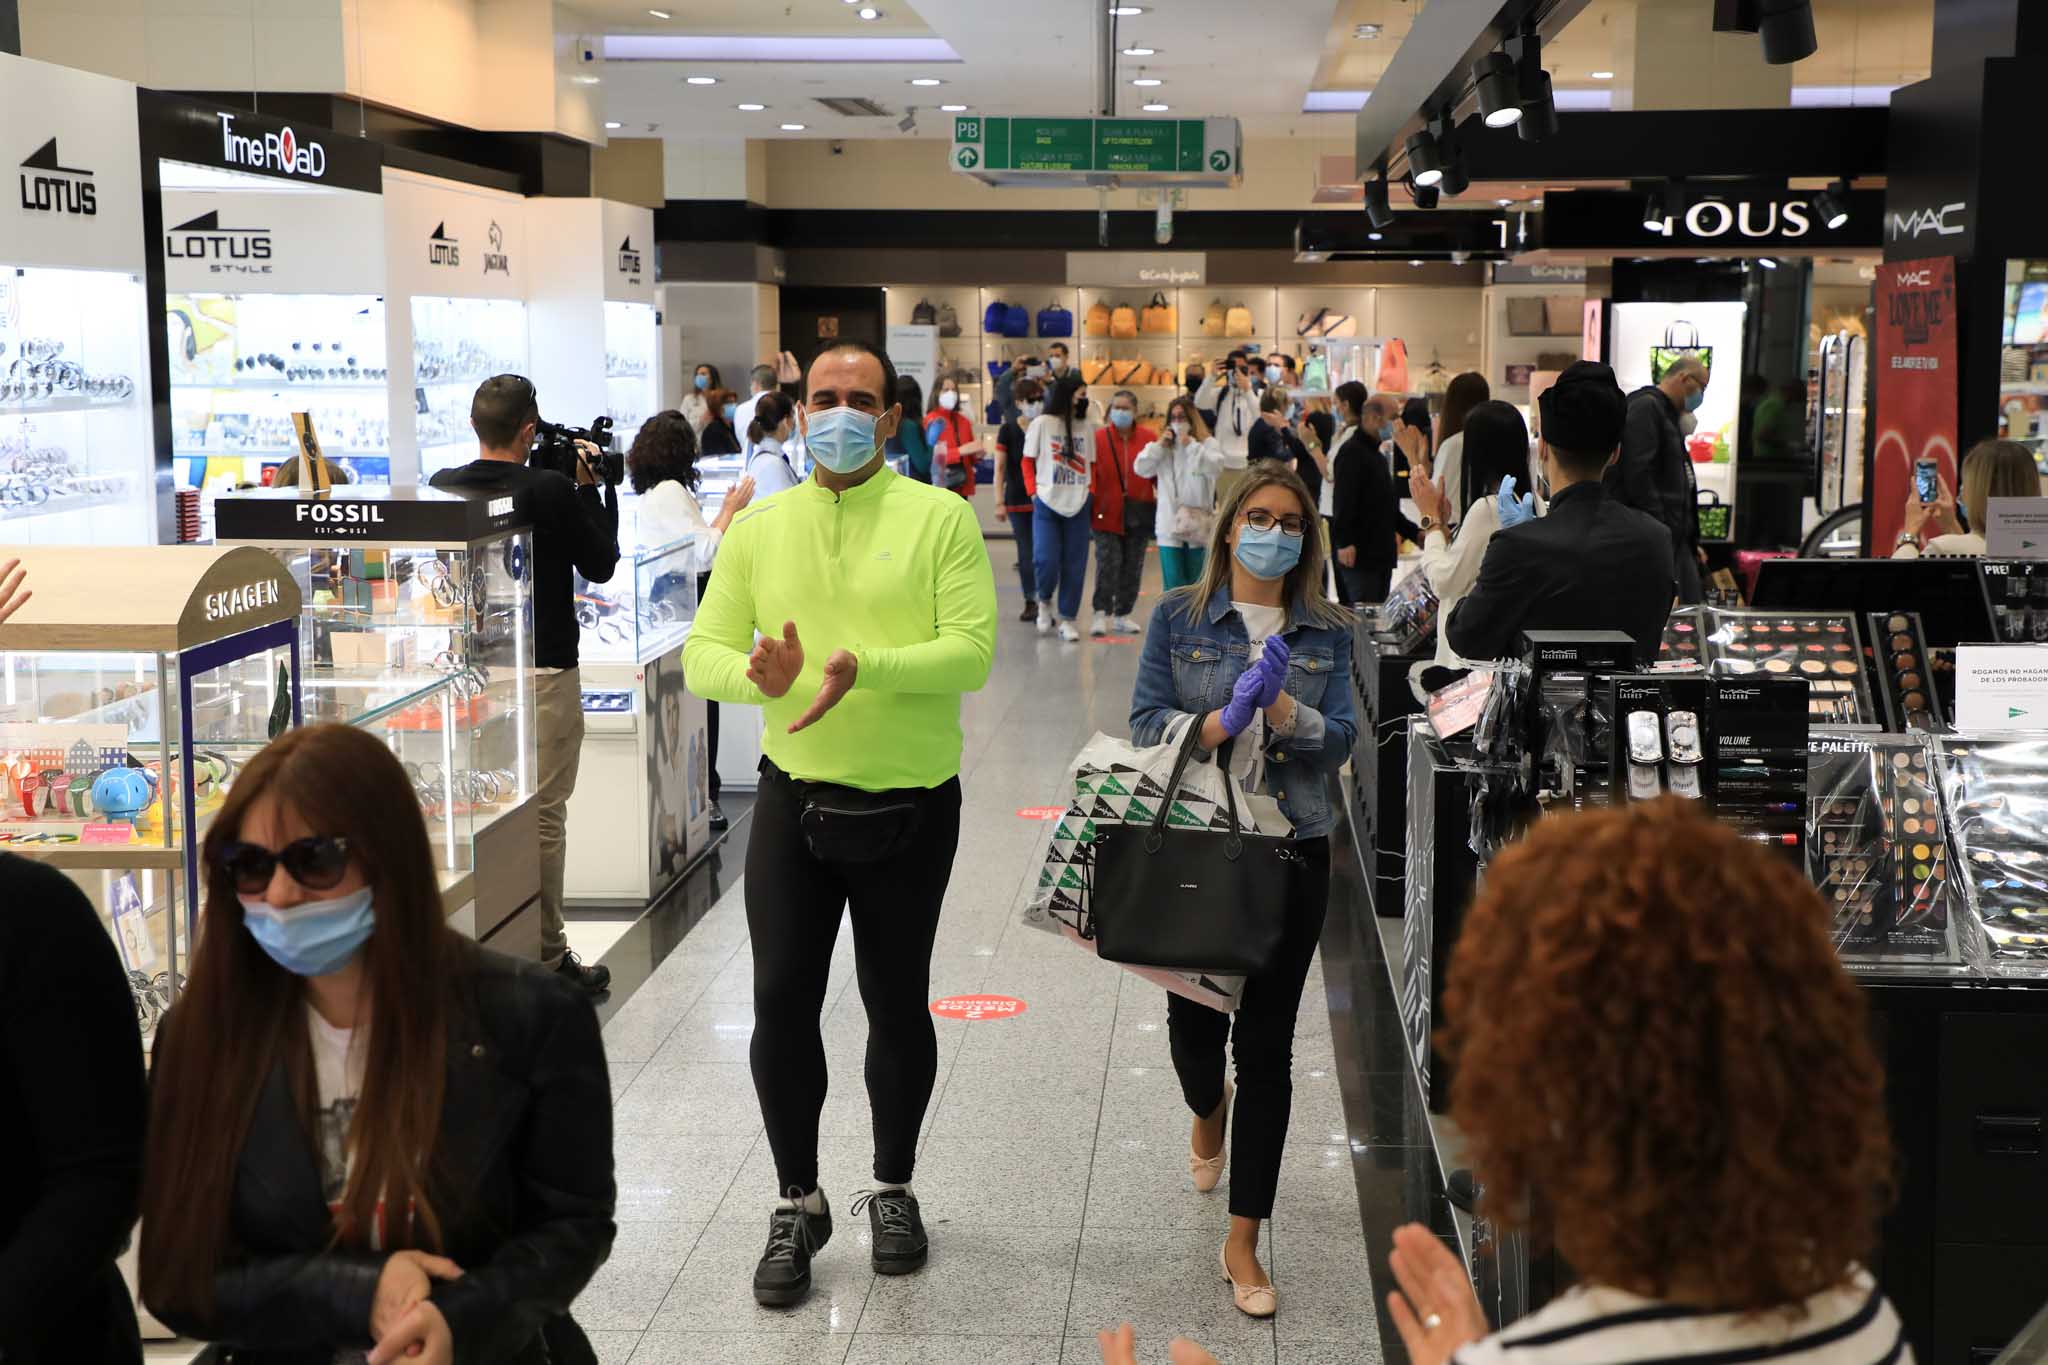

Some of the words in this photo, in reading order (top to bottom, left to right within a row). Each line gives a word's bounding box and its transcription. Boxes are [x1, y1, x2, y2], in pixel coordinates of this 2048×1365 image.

[957, 122, 978, 138] PB
[20, 174, 97, 216] LOTUS
[166, 235, 272, 259] LOTUS
[429, 243, 460, 267] LOTUS
[209, 264, 273, 274] STYLE
[618, 253, 641, 274] LOTUS
[296, 503, 385, 523] FOSSIL
[349, 526, 368, 534] USA
[205, 578, 280, 622] SKAGEN
[1719, 736, 1751, 745] VOLUME
[937, 1004, 1015, 1012] Metros
